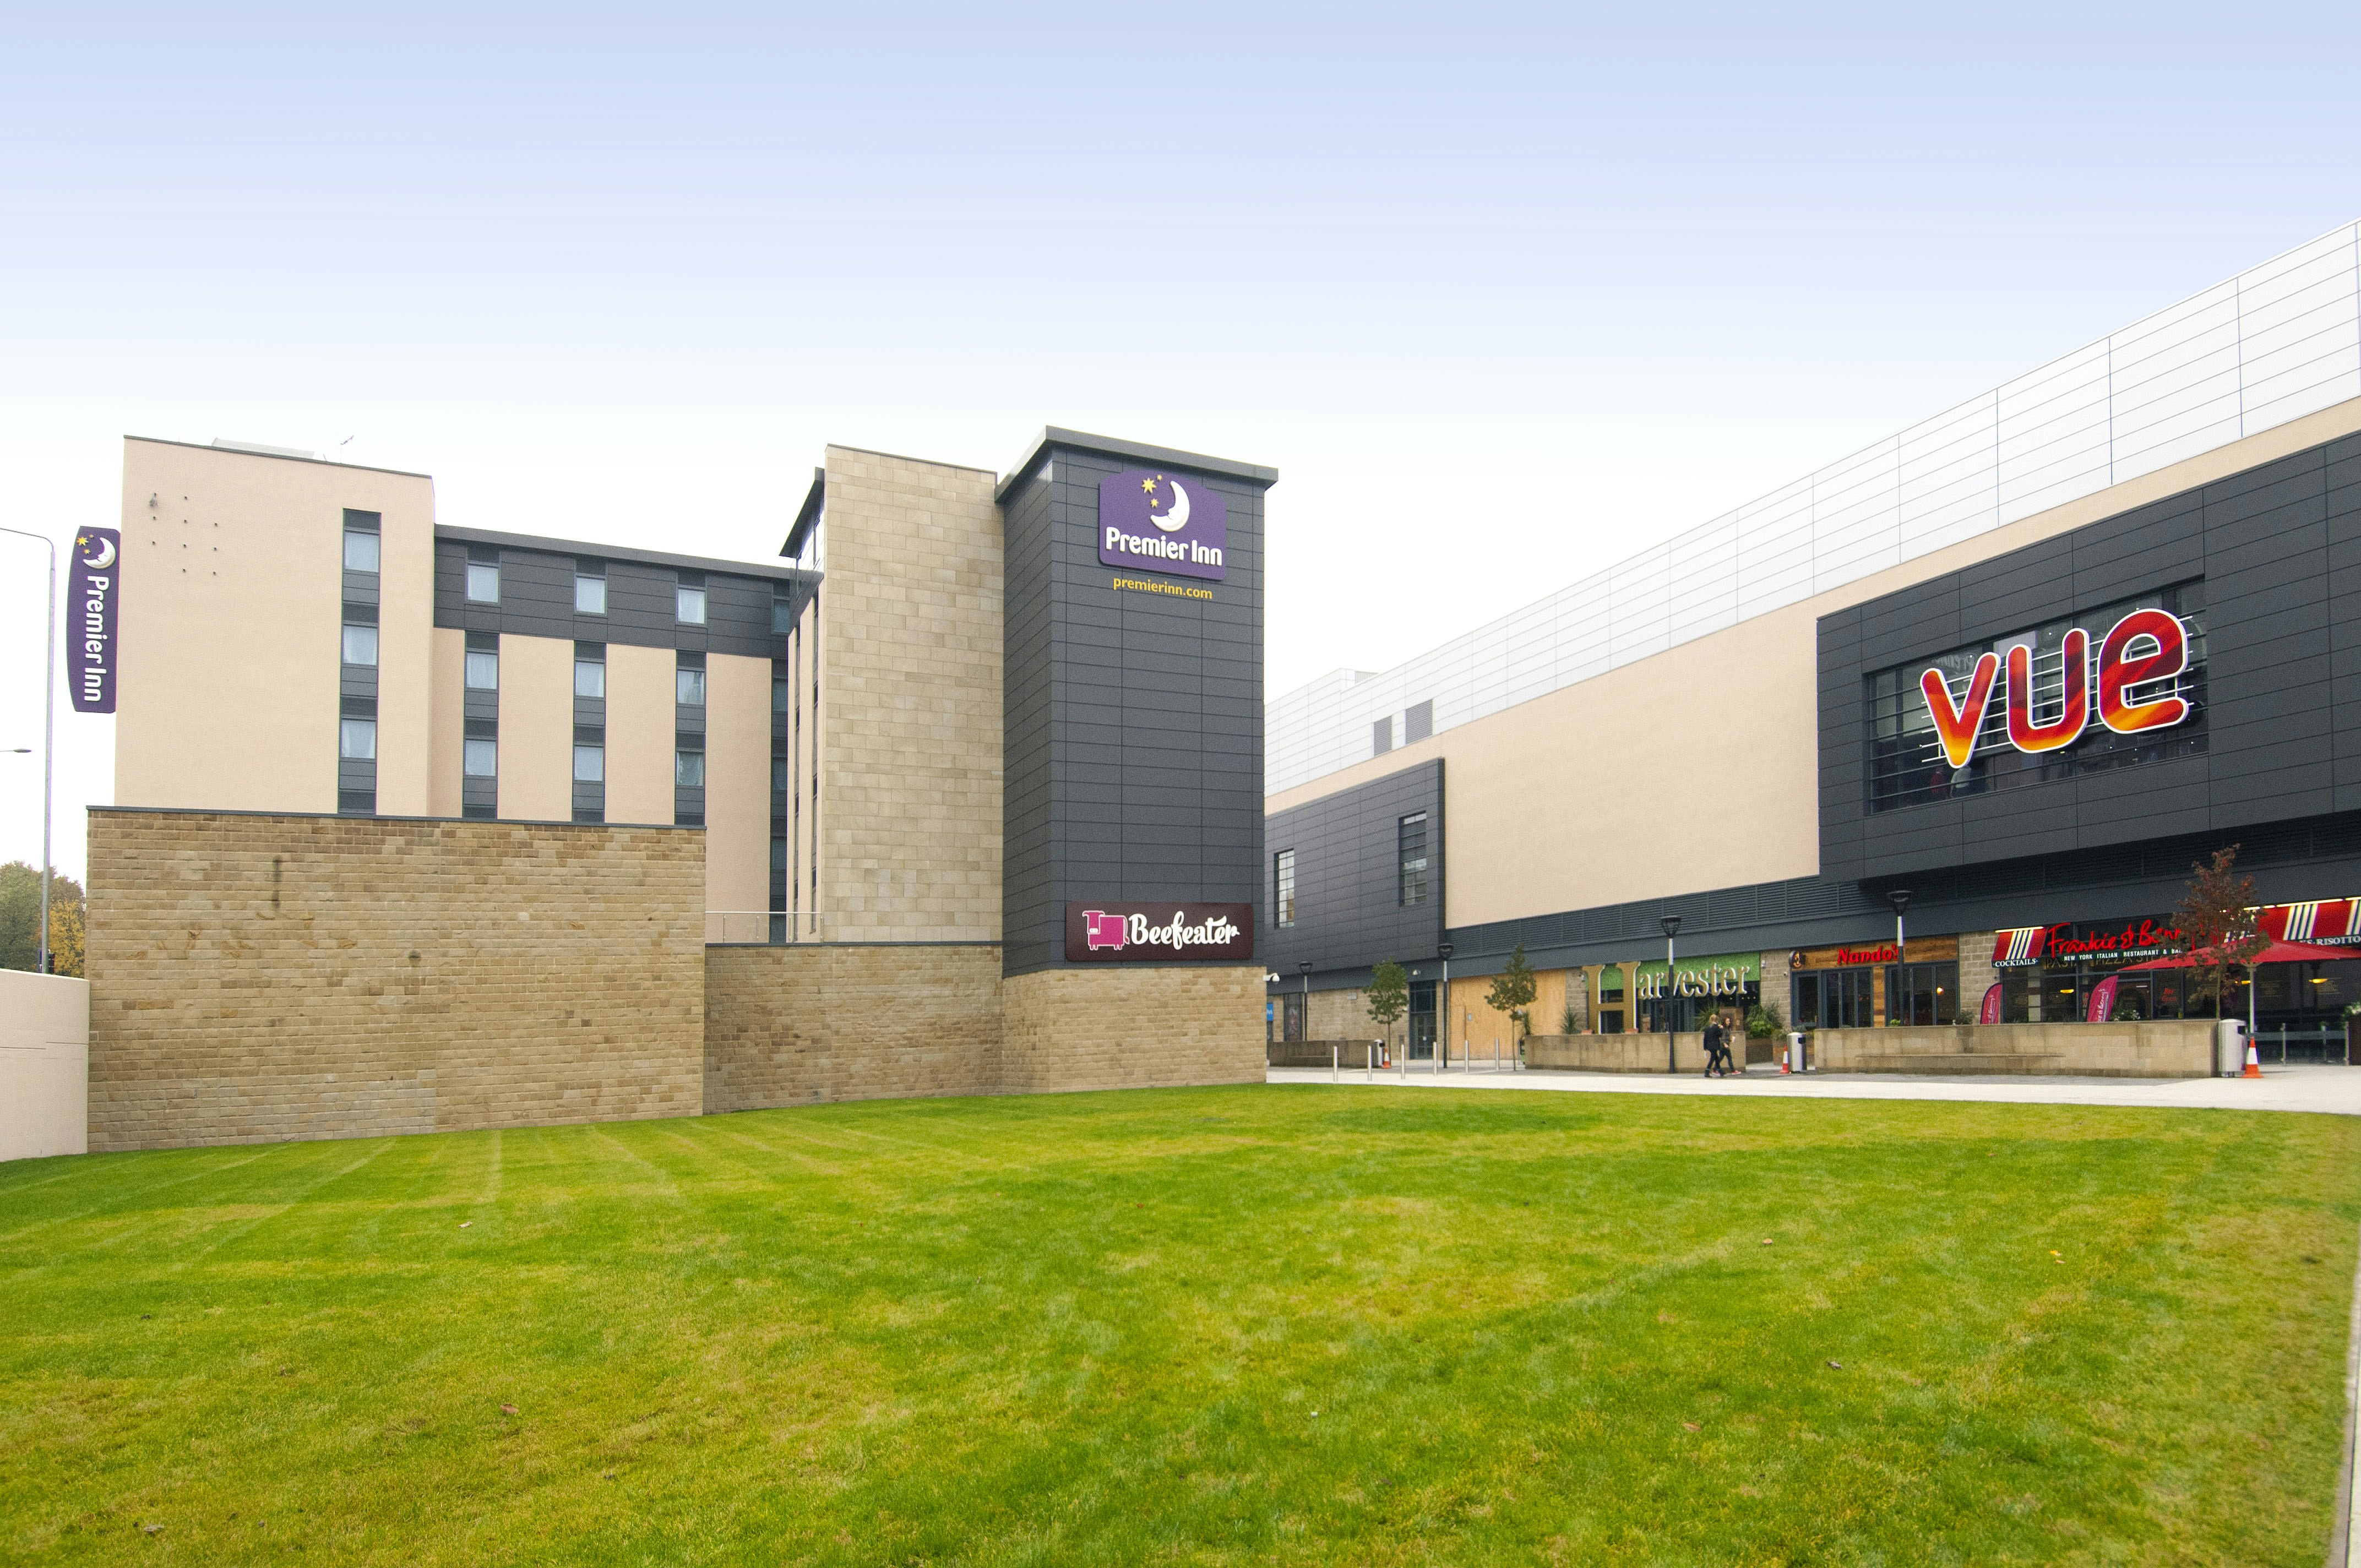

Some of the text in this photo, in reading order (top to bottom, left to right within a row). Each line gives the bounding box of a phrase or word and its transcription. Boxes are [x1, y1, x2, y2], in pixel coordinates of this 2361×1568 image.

[1106, 526, 1222, 566] Premier Inn
[1113, 577, 1212, 600] premierinn.com
[84, 575, 110, 701] Premier Inn
[1129, 911, 1240, 950] Beefeater
[2048, 922, 2116, 958] Frankie
[1837, 944, 1898, 965] Nando's
[1995, 959, 2036, 967] COCKTAILS
[2123, 949, 2159, 957] RESTAURANT
